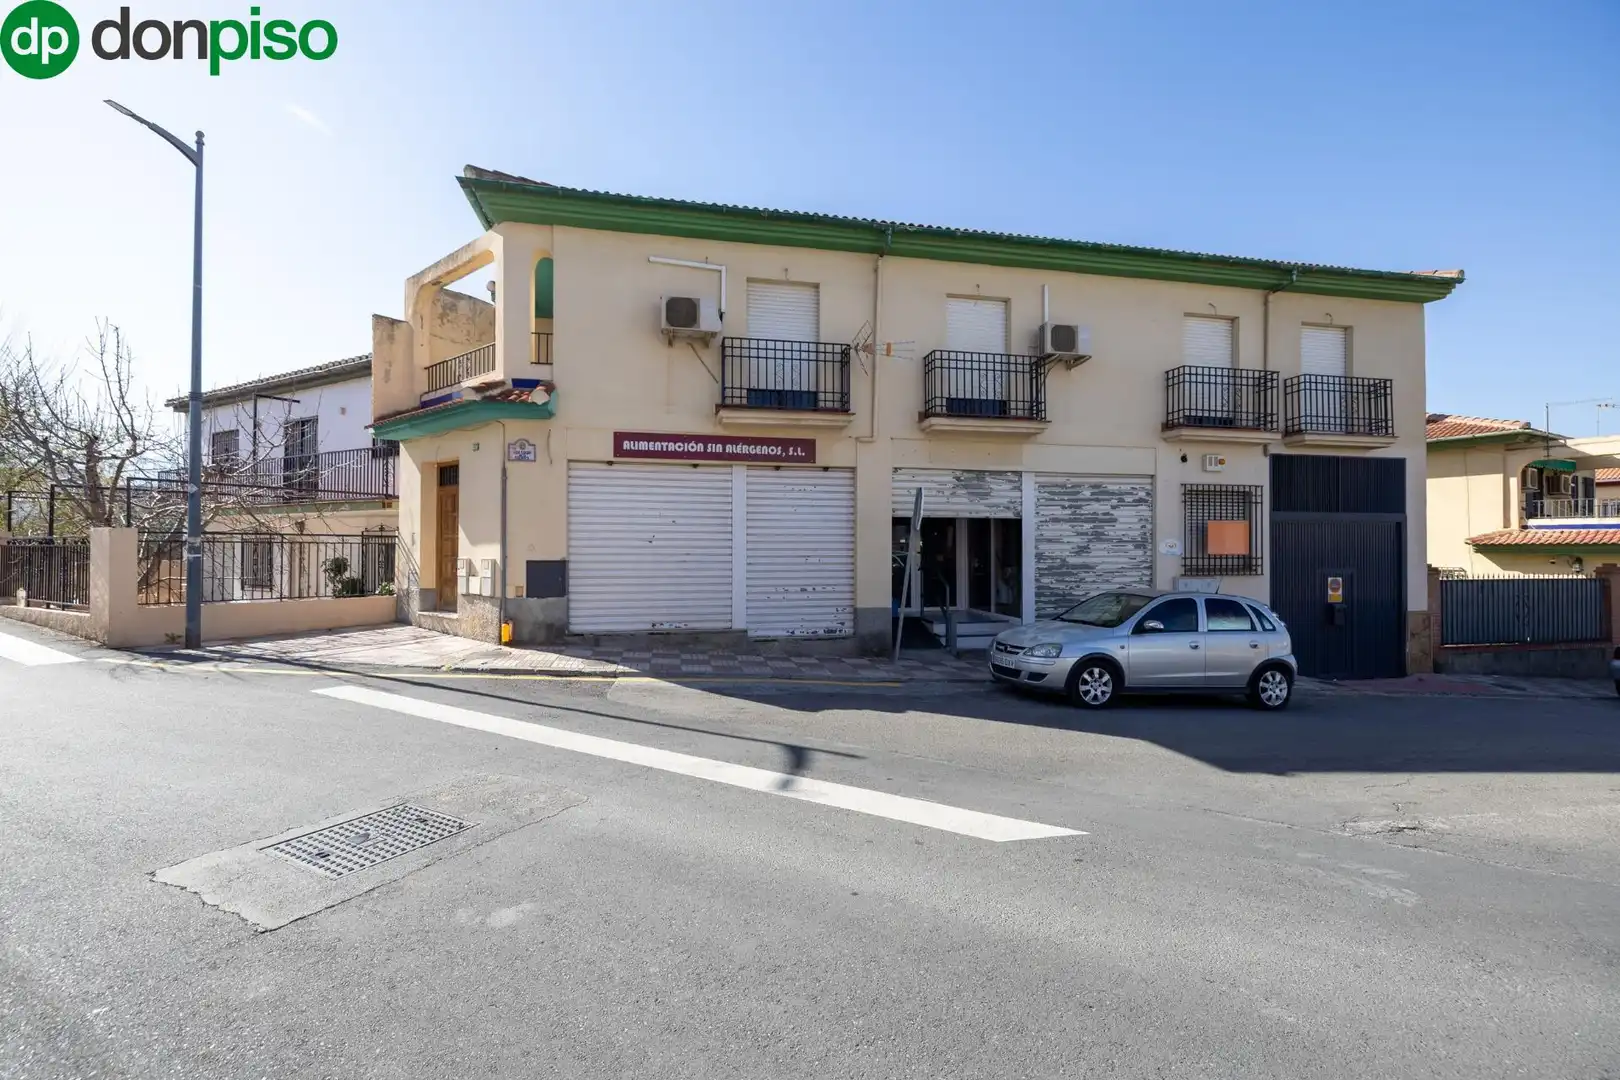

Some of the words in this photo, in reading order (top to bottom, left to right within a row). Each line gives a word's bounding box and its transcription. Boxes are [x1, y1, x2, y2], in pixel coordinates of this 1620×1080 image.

[623, 440, 703, 453] ALIMENTACIÓN
[707, 443, 723, 453] SIN
[726, 443, 786, 458] ALÉRGENOS,
[788, 447, 806, 456] S.L.
